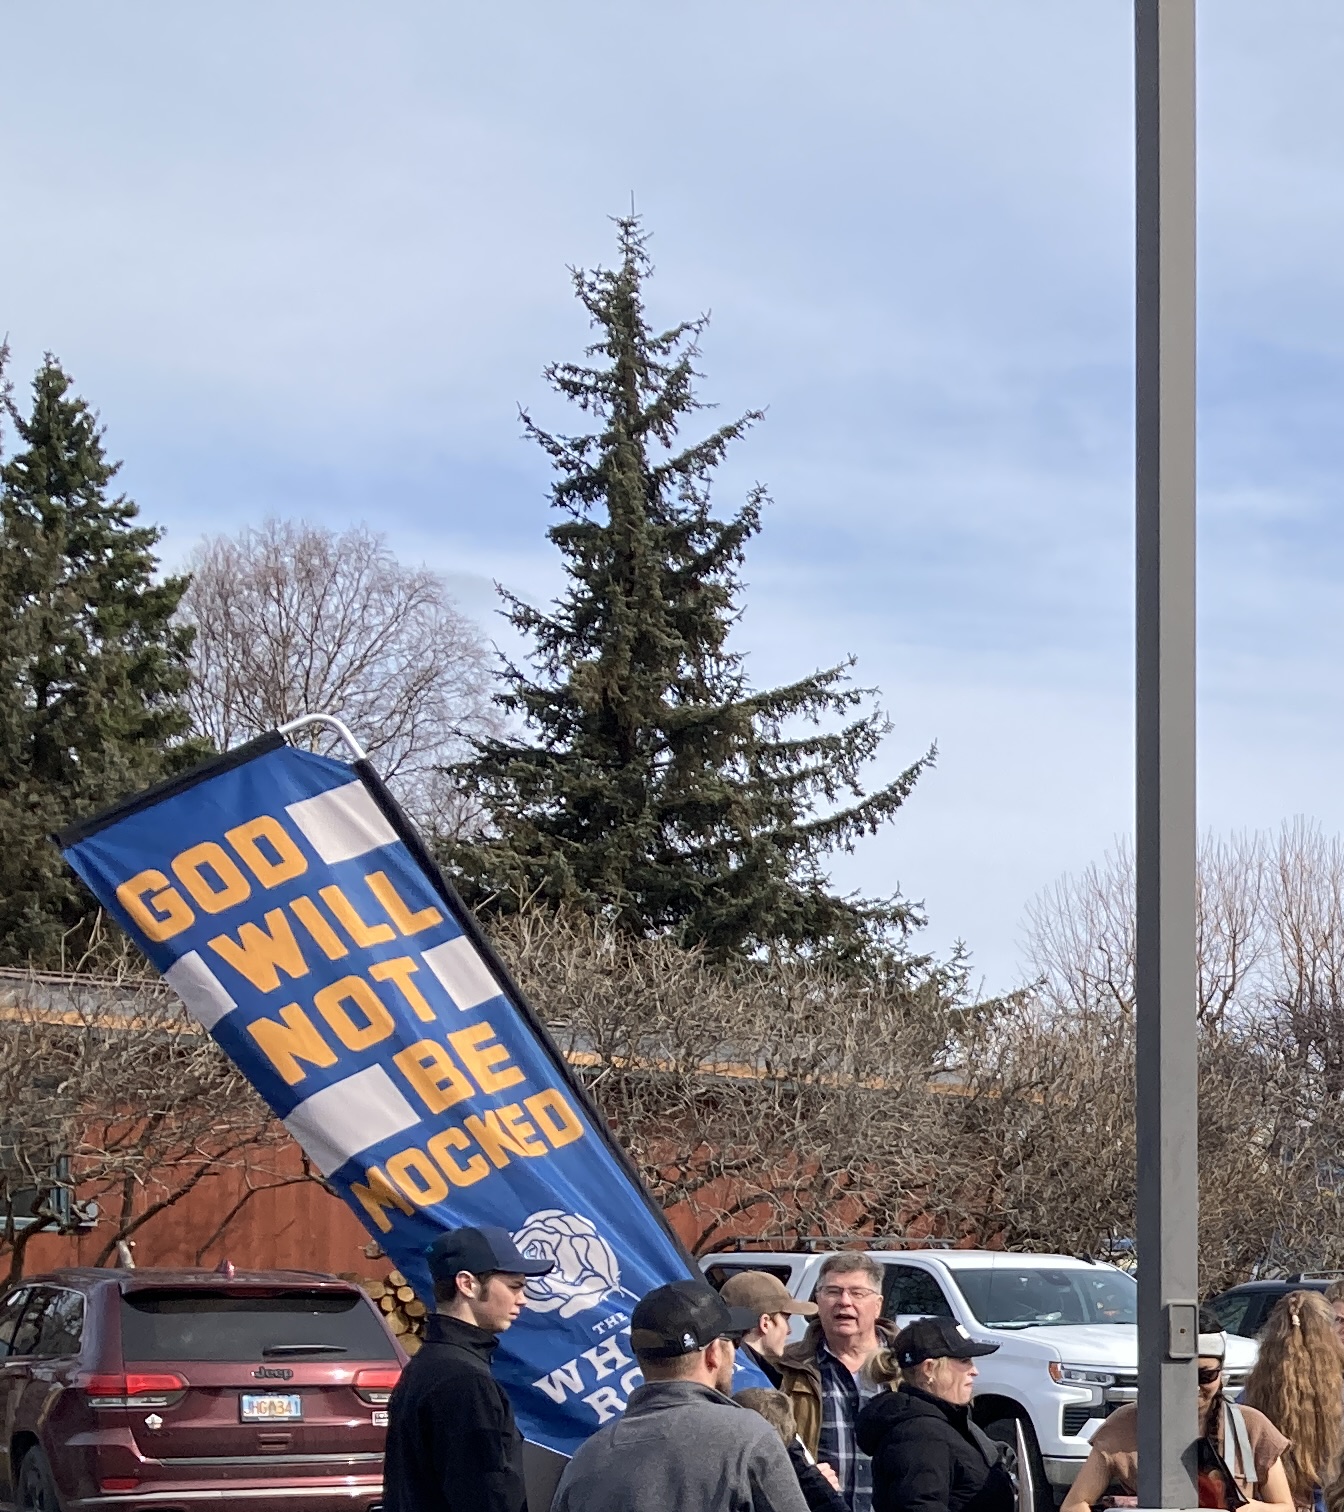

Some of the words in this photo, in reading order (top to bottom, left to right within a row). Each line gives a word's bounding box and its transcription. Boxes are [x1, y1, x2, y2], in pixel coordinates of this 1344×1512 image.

[115, 814, 309, 943] GOD
[209, 871, 444, 994] WILL
[247, 954, 438, 1087] NOT
[392, 1021, 521, 1116] BE
[350, 1087, 586, 1235] MOCKED
[251, 1365, 294, 1381] Jeep
